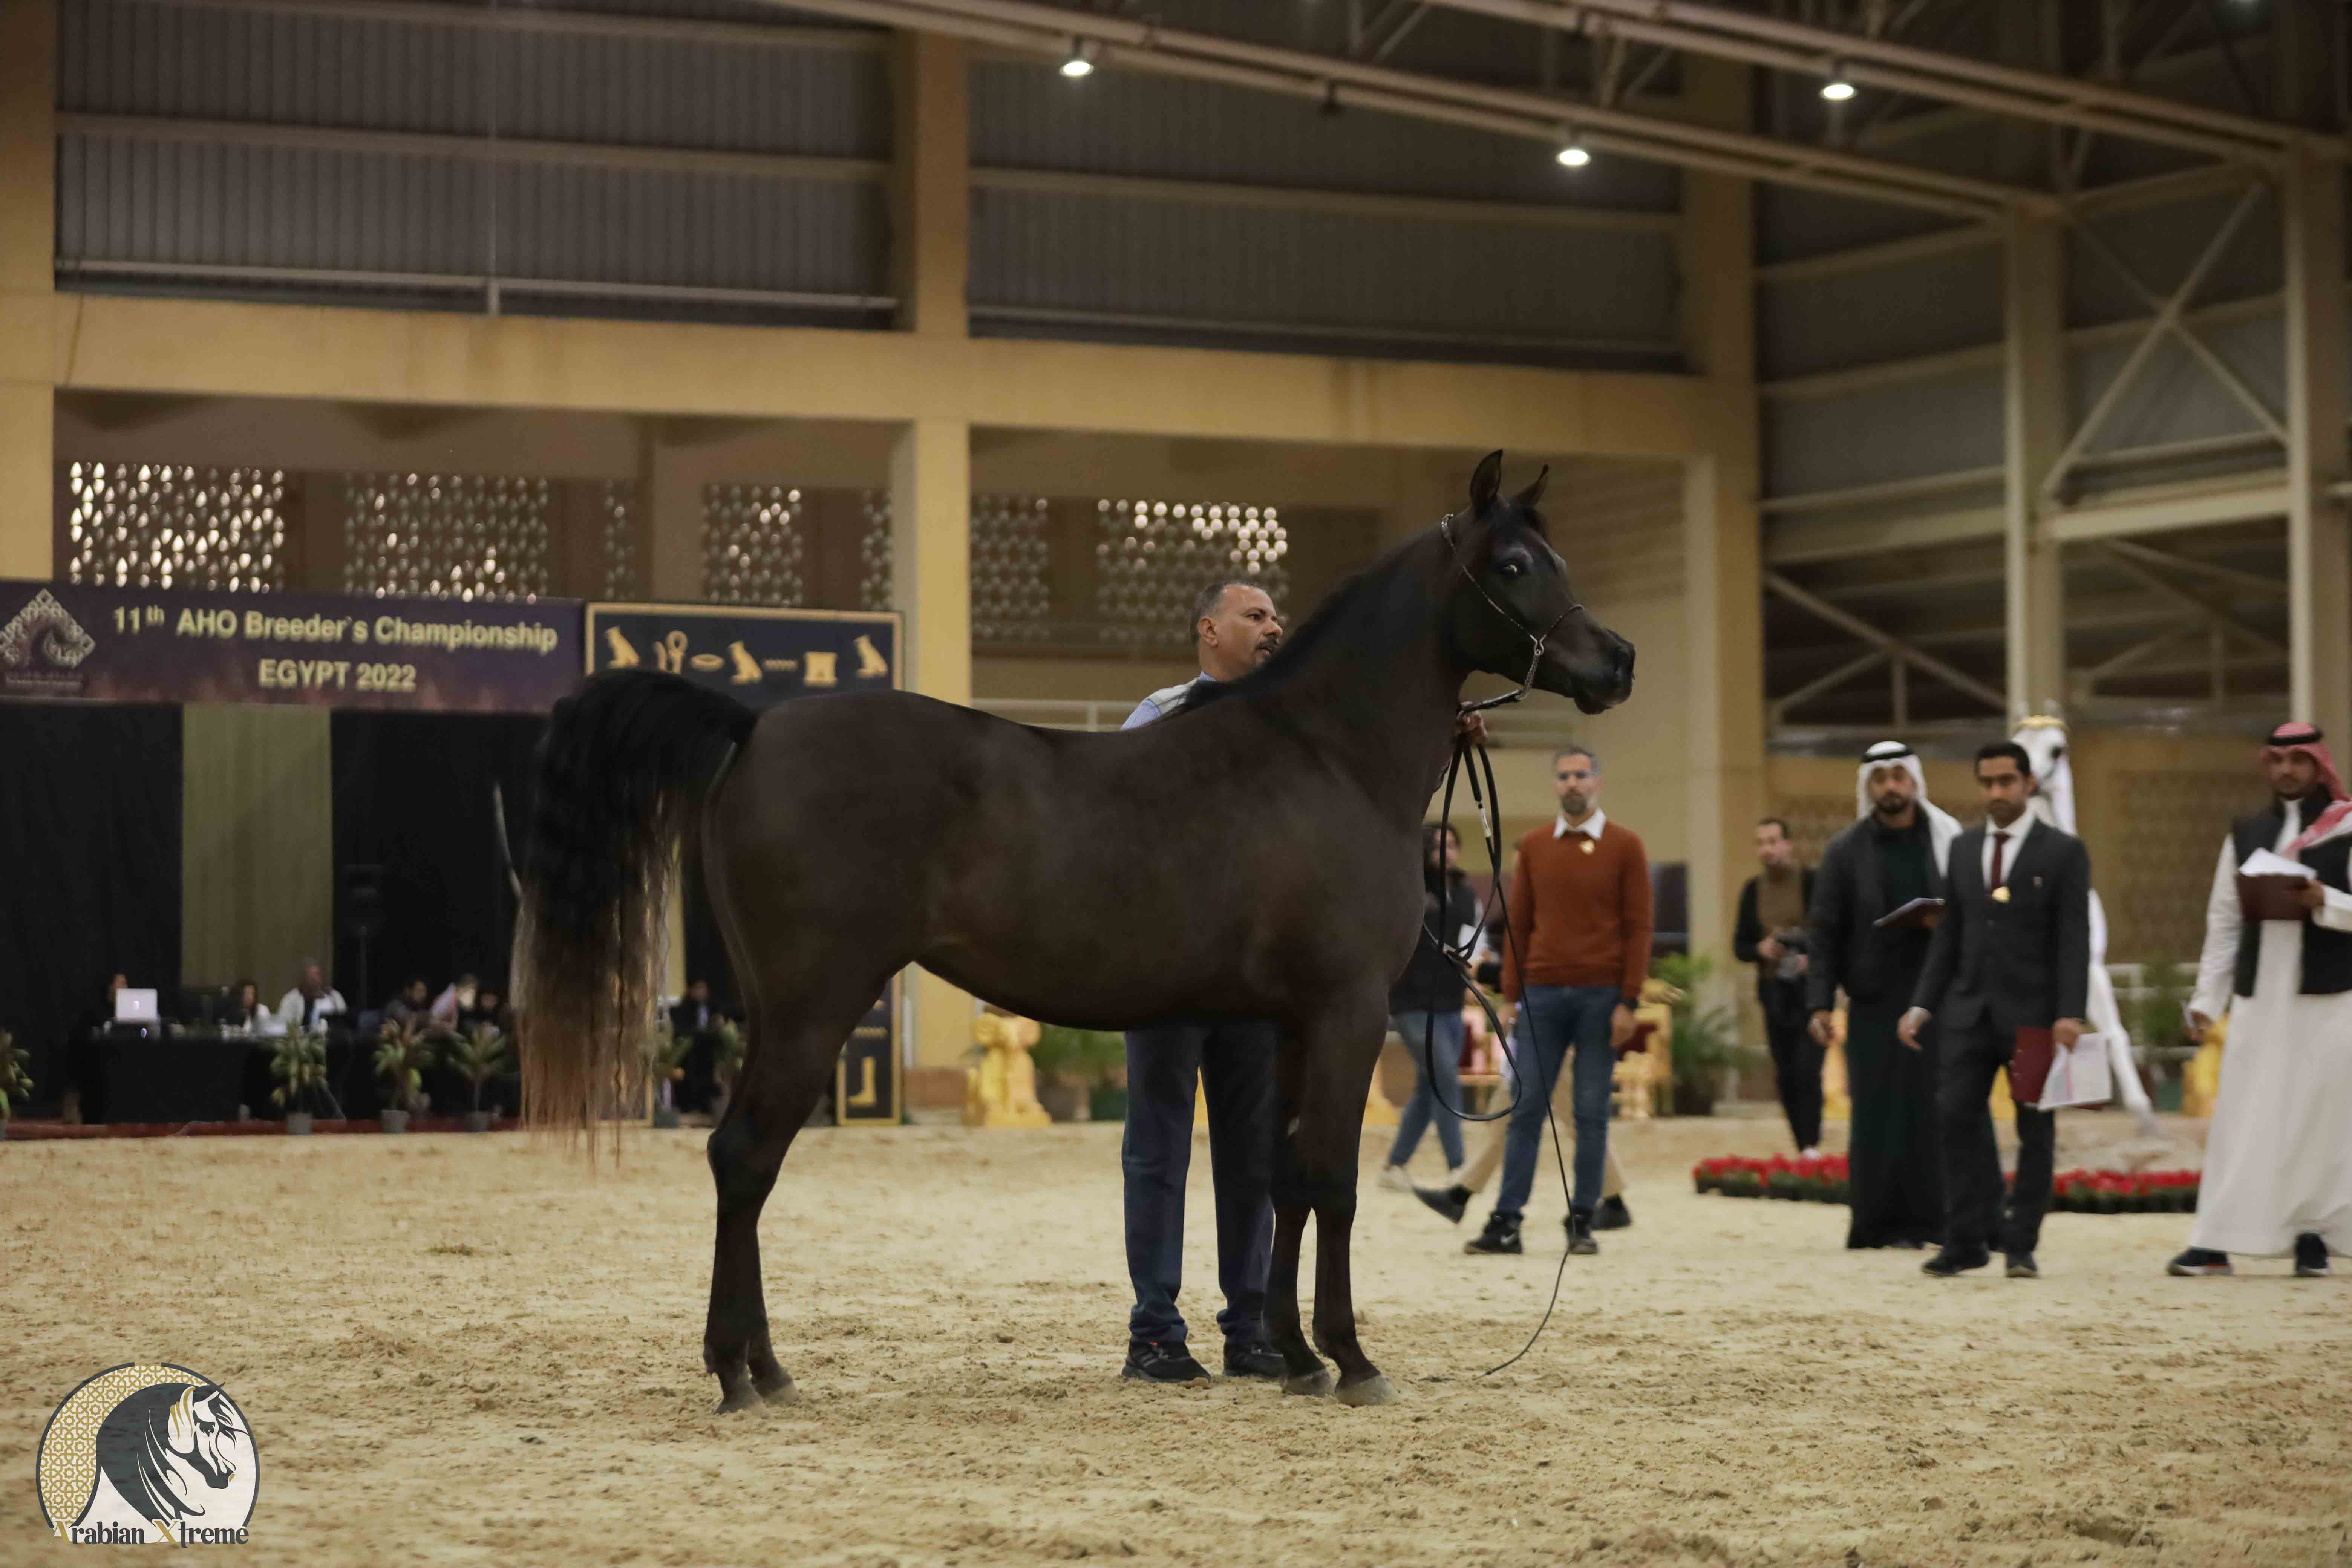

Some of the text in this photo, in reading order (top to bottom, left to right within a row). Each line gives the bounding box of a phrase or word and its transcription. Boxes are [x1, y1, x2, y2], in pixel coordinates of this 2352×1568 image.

[175, 608, 238, 639] AHO
[374, 615, 558, 656] Championship
[259, 658, 416, 692] EGYPT 2022
